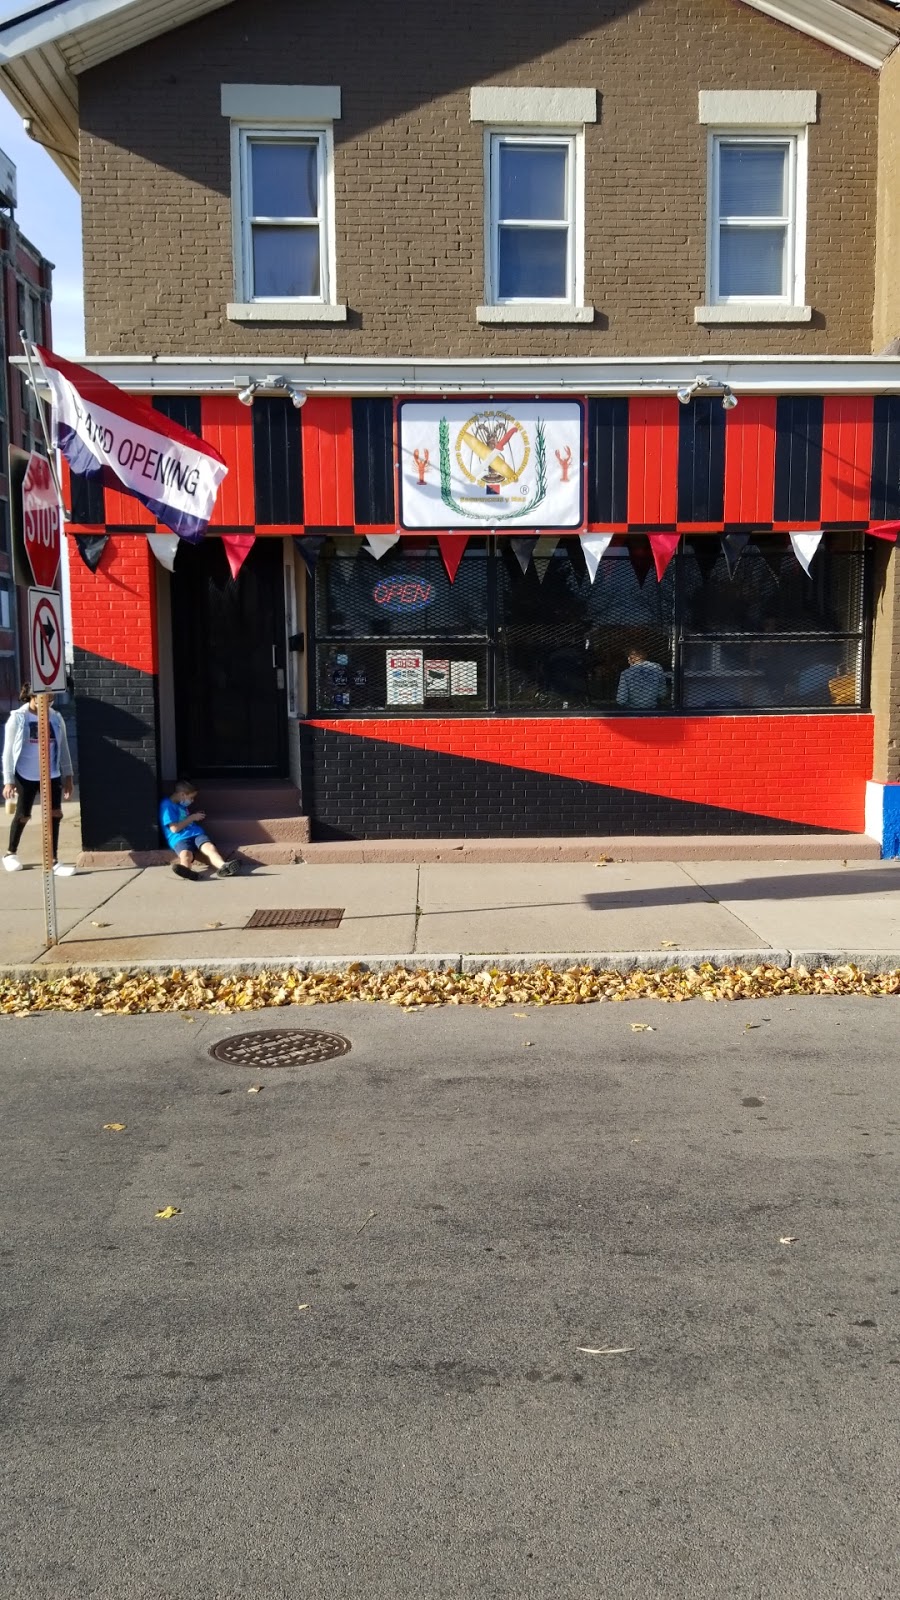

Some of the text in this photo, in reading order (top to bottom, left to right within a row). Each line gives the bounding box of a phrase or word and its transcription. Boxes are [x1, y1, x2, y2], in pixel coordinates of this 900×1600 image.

[117, 438, 200, 497] OPENING
[27, 493, 58, 549] STOP
[373, 584, 431, 604] OPEN
